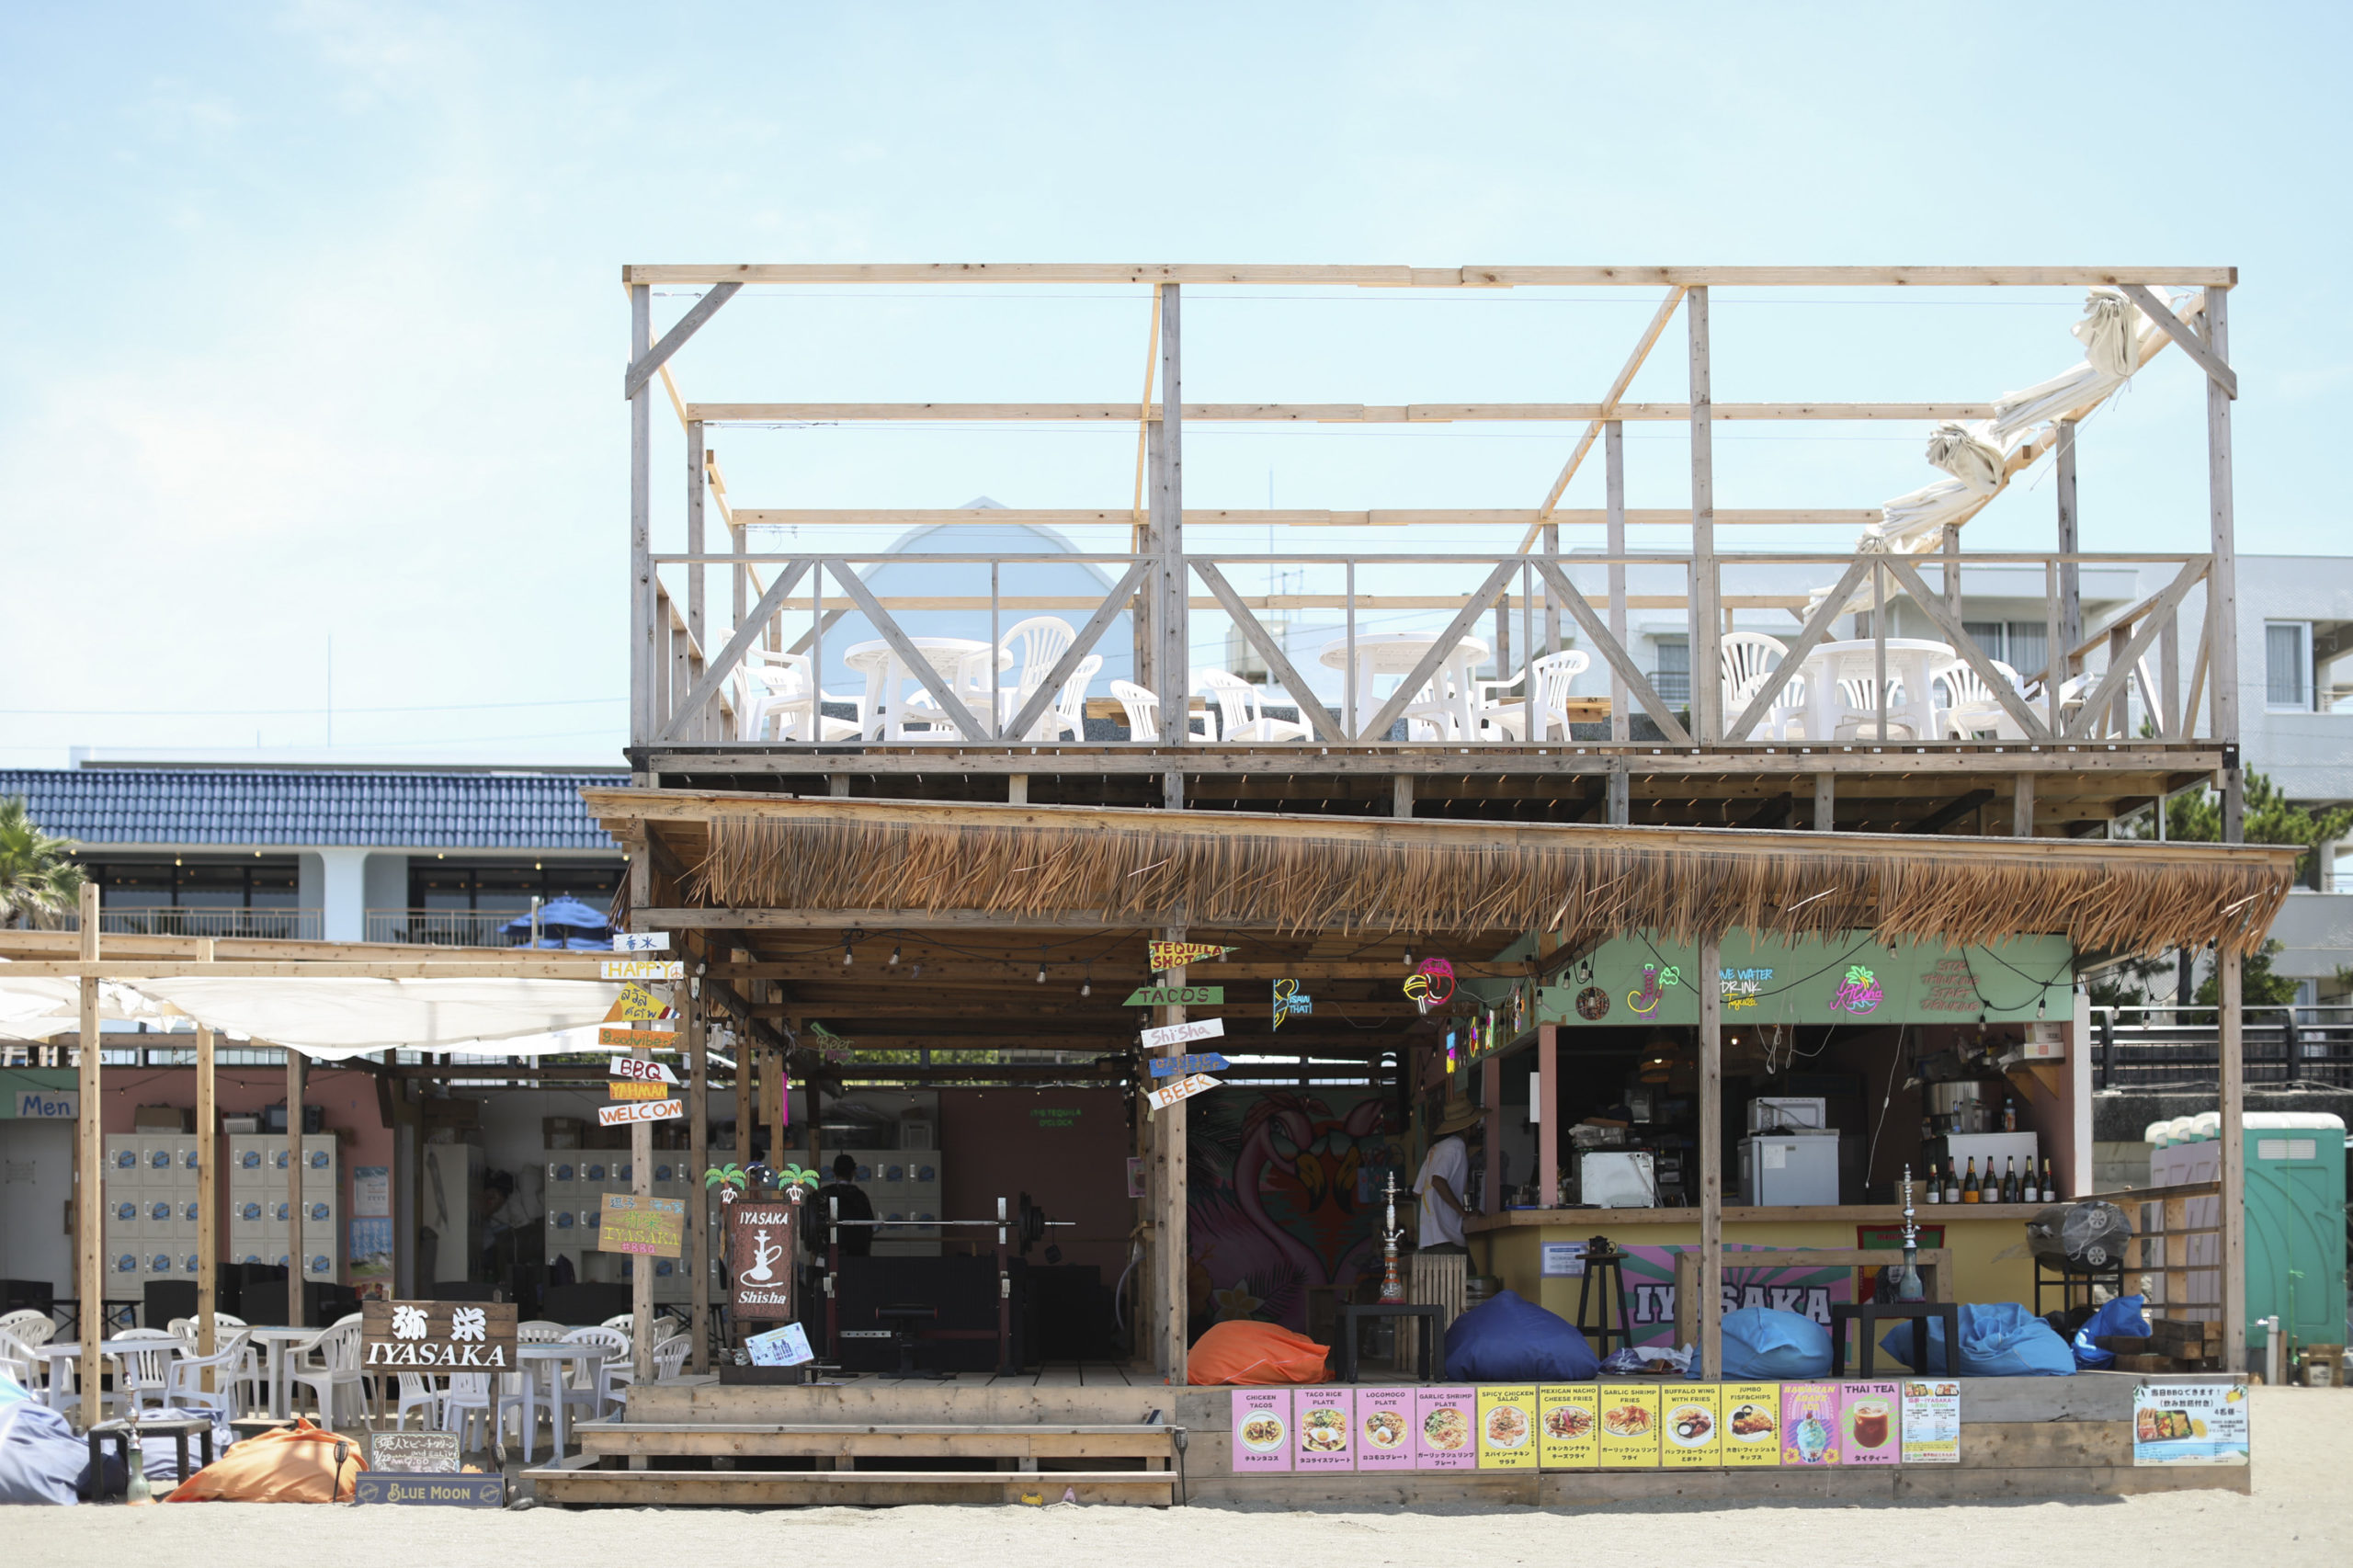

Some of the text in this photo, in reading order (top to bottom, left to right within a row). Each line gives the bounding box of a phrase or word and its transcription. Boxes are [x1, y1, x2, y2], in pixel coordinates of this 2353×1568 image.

[1151, 941, 1222, 956] TEQUILA
[1152, 955, 1195, 968] SHOT
[608, 961, 676, 979] HAPPY
[1737, 969, 1773, 981] WATER
[1720, 980, 1763, 994] DRINK
[1138, 988, 1210, 1003] TACOS
[1830, 983, 1883, 1009] Aloha
[620, 1059, 663, 1080] BBQ
[610, 1083, 668, 1098] YAHMAN
[1158, 1073, 1212, 1106] BEER
[22, 1095, 71, 1116] Men
[739, 1211, 789, 1226] IYASAKA
[603, 1226, 679, 1245] IYASAKA
[621, 1242, 655, 1254] #BBQ
[738, 1290, 787, 1304] Shisha
[392, 1305, 486, 1342] 弥栄
[366, 1343, 506, 1367] IYASAKA
[1845, 1385, 1895, 1393] THAI TEA
